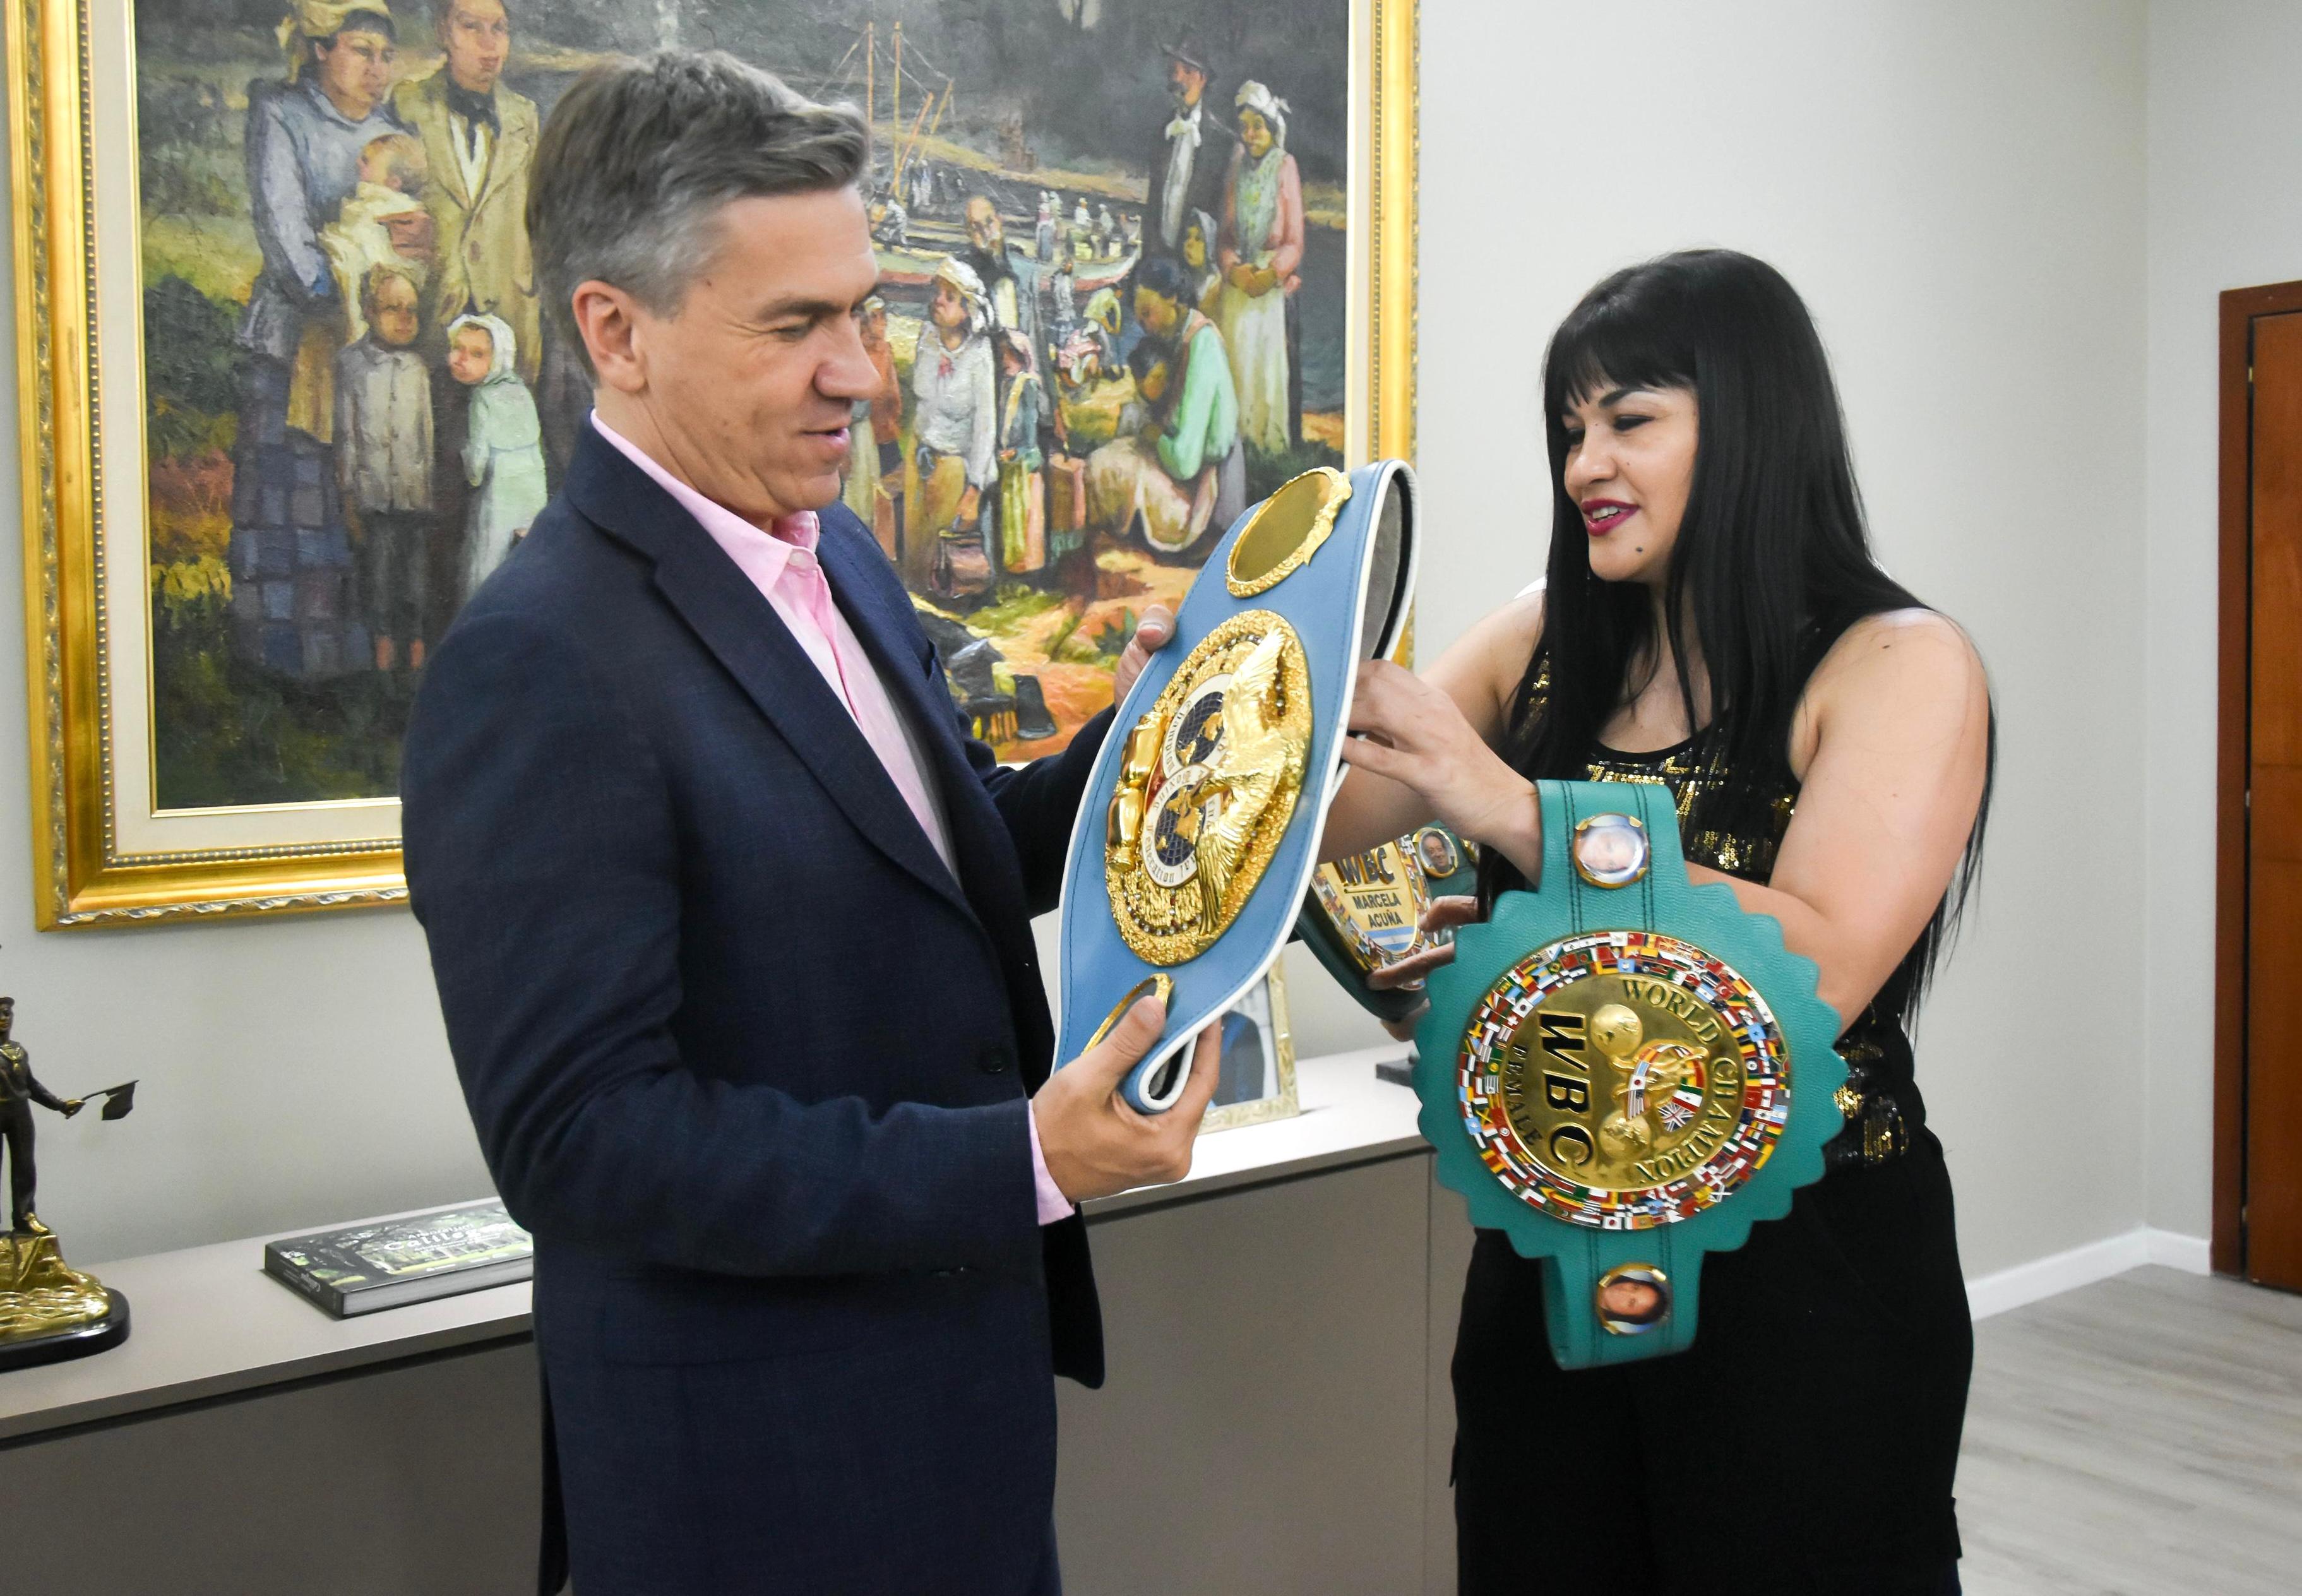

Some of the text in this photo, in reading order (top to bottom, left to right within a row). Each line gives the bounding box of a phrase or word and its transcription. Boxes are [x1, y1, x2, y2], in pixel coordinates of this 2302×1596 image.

[1332, 847, 1395, 886] WBC
[1352, 892, 1402, 910] MARCELA
[1368, 909, 1404, 929] ACUÑA
[1505, 1045, 1544, 1146] FEMALE
[1538, 1010, 1594, 1165] WBC
[1619, 977, 1739, 1183] WORLD CHAMPION
